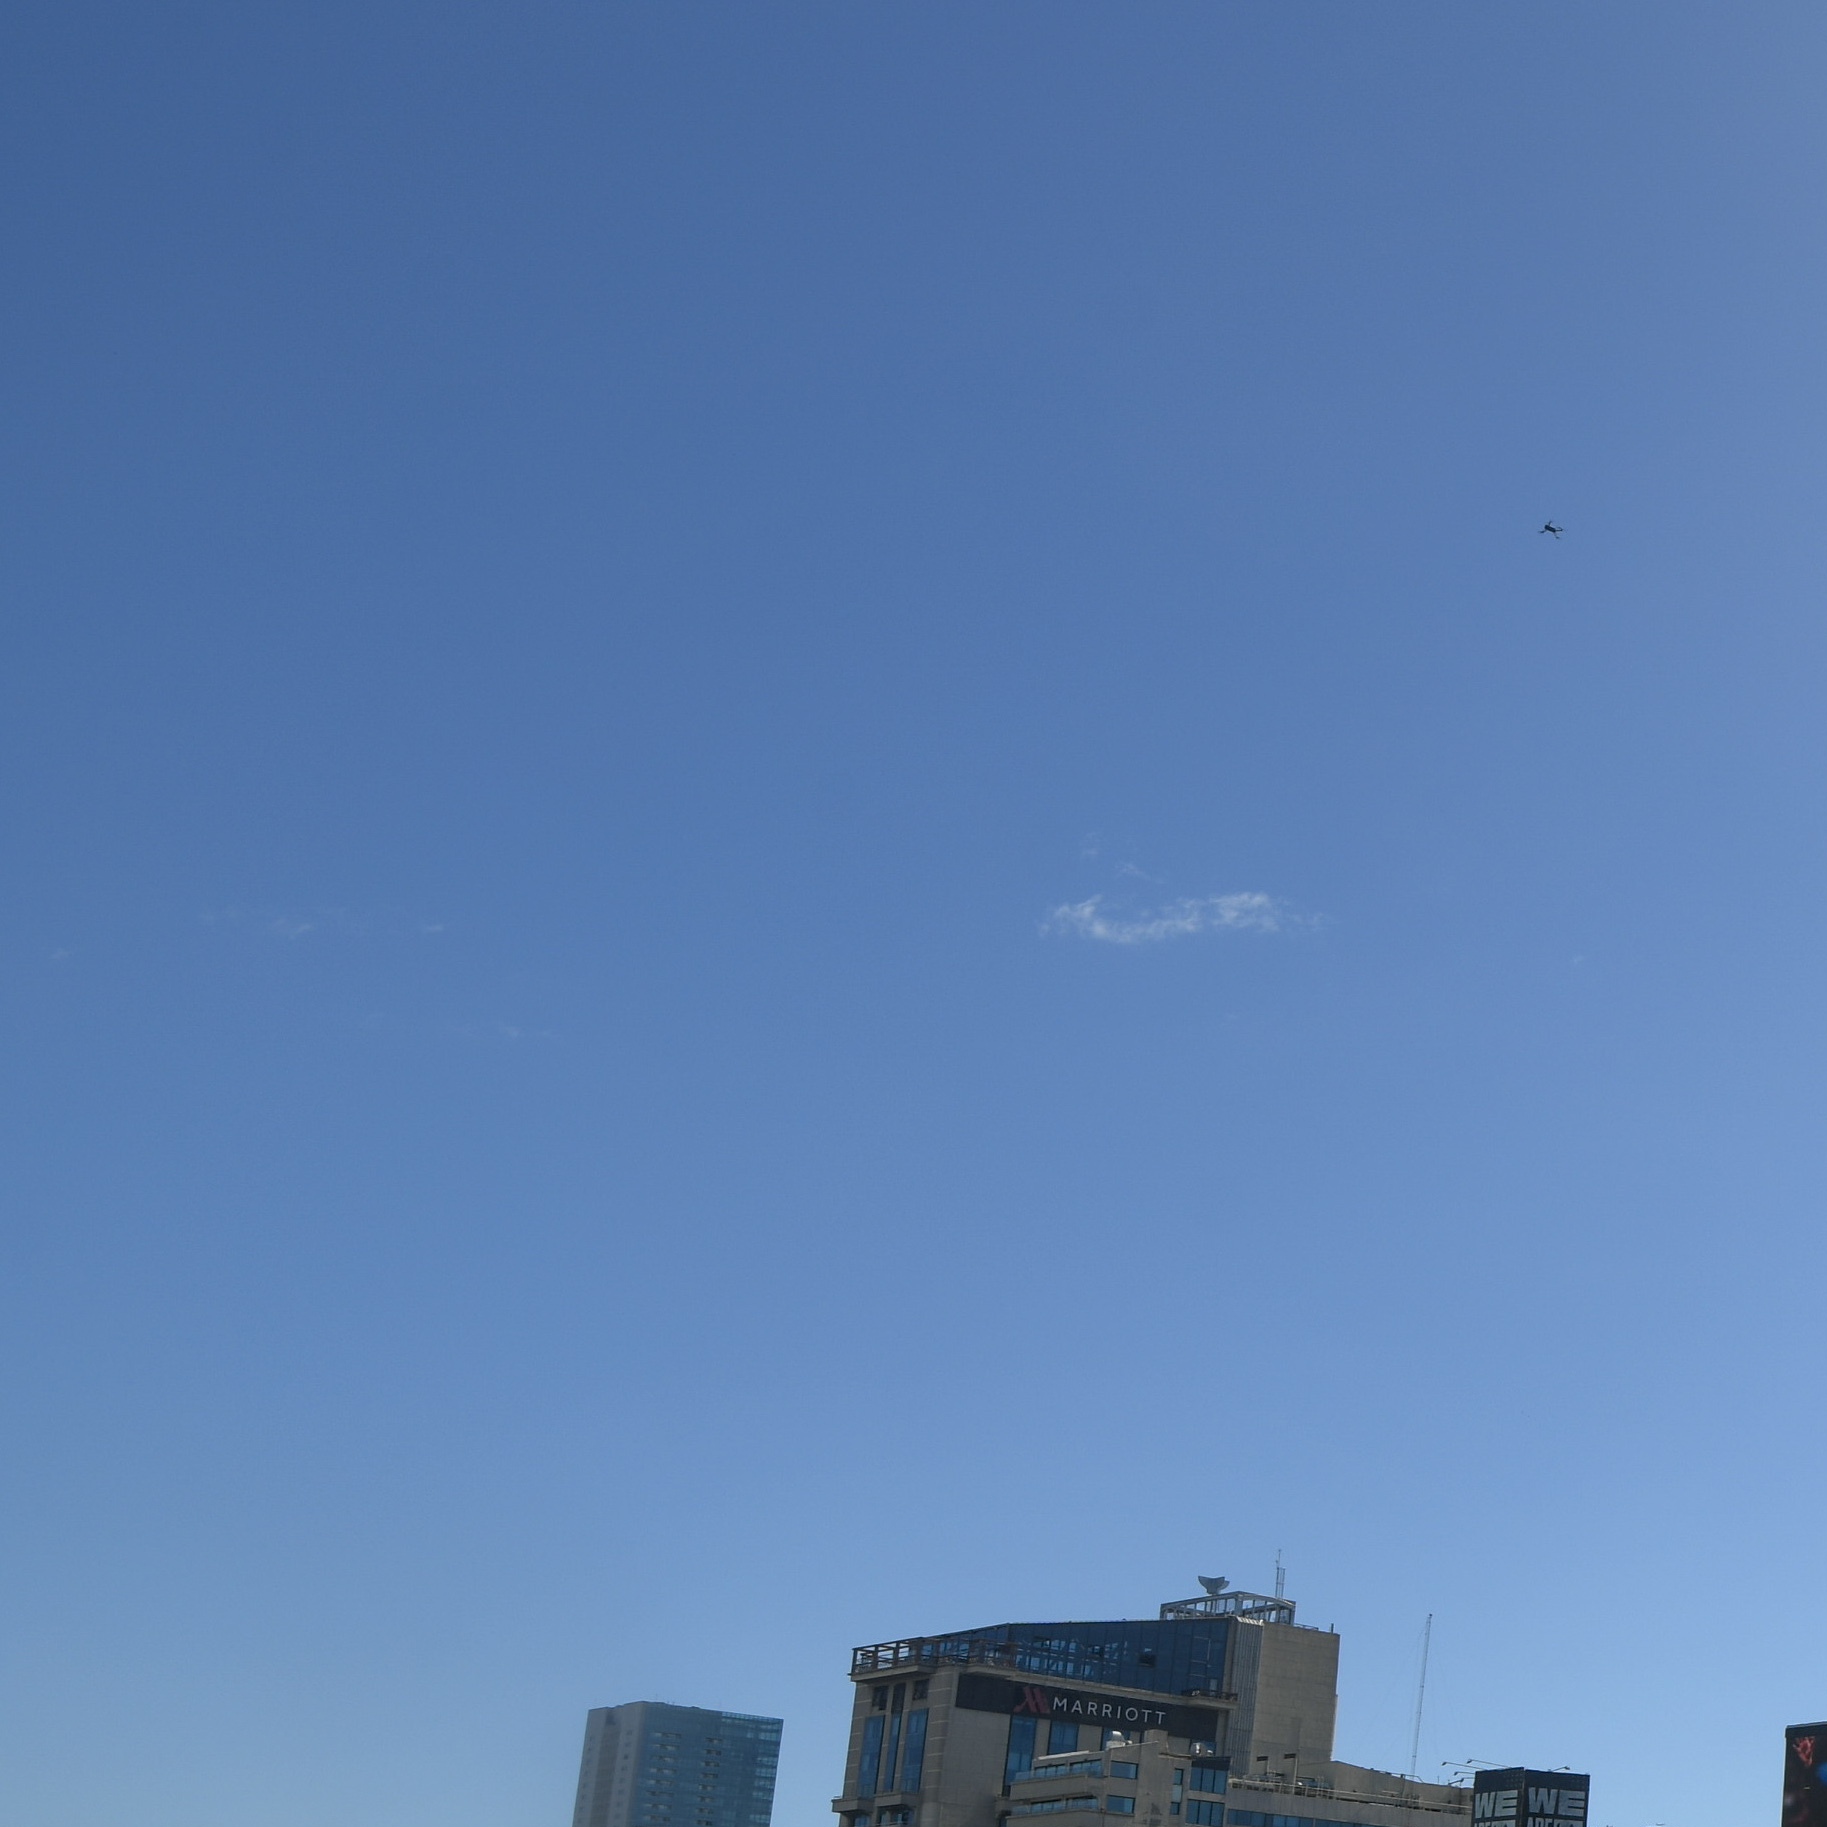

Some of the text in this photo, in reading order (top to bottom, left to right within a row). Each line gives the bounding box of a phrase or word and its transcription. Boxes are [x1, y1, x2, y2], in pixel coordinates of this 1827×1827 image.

[1053, 1697, 1166, 1725] MARRIOTT
[1475, 1789, 1518, 1818] WE
[1528, 1787, 1585, 1816] WE
